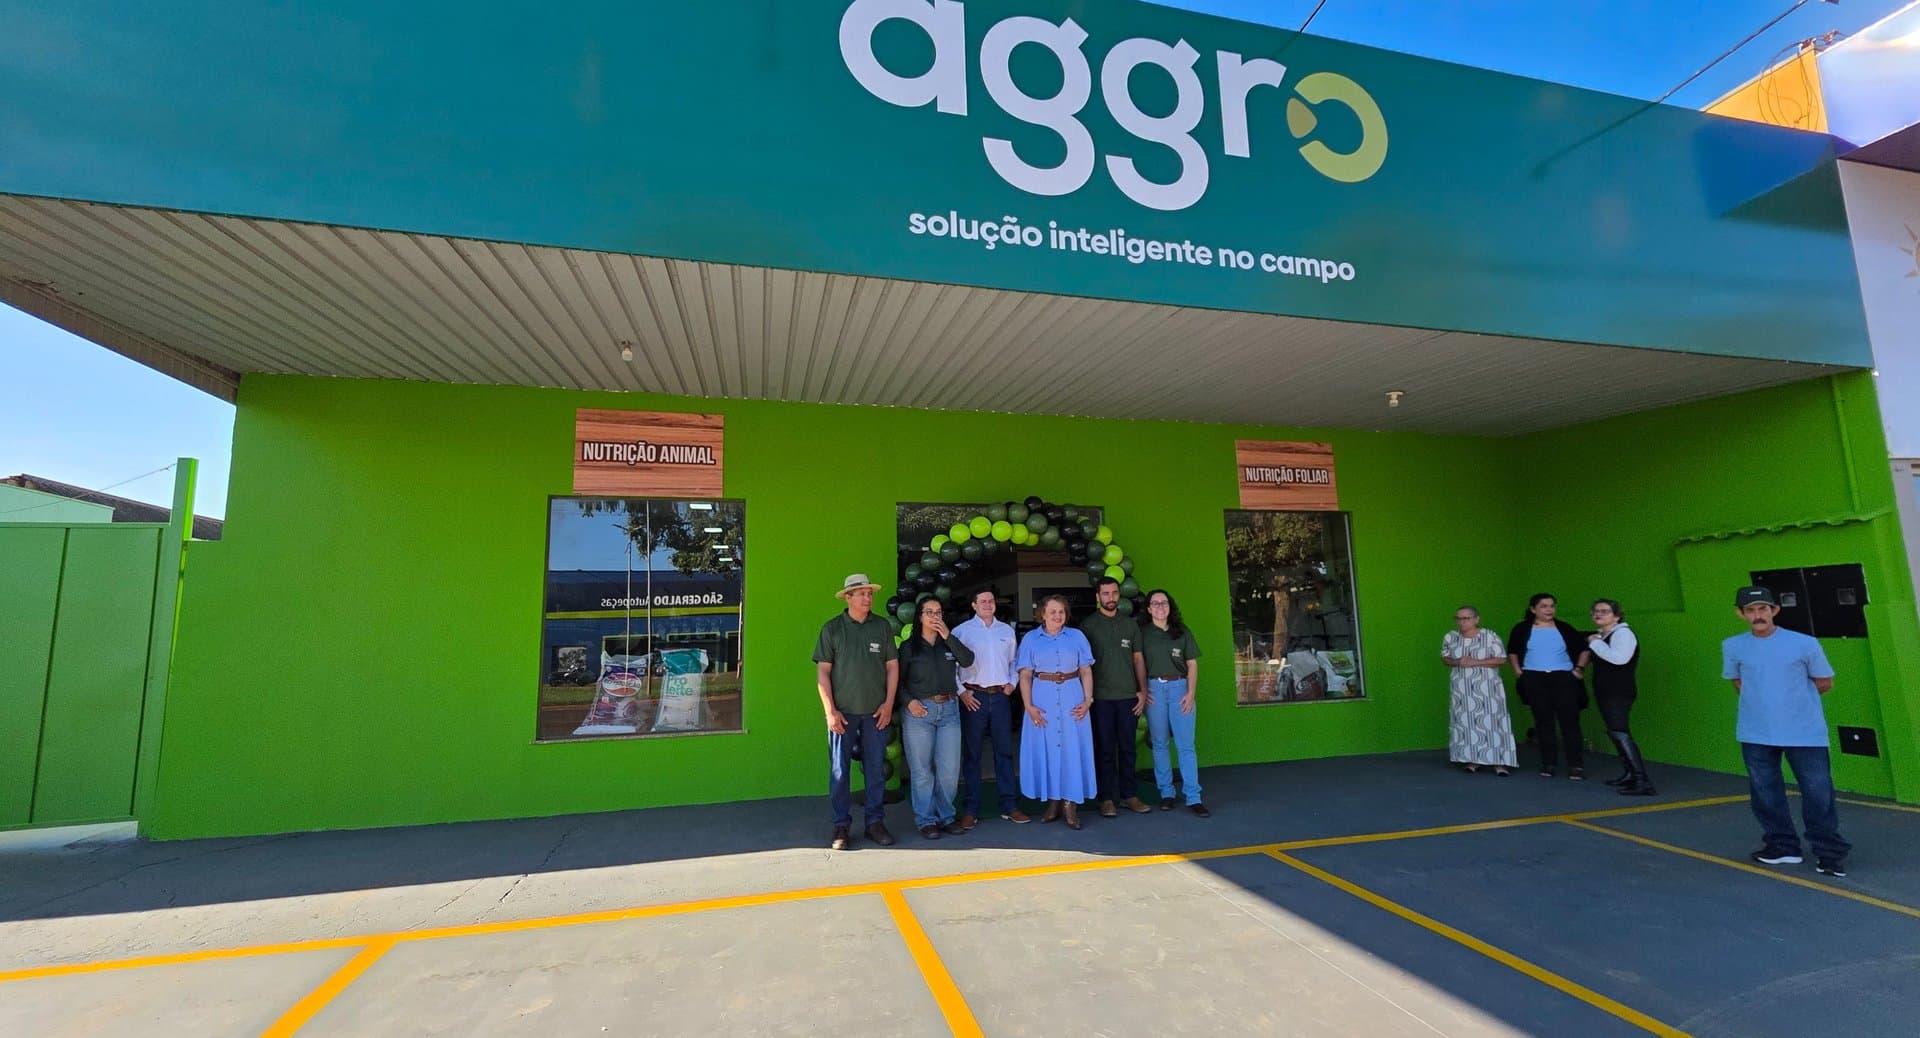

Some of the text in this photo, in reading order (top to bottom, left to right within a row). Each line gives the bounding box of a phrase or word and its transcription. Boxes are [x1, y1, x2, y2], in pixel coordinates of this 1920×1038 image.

[838, 0, 1388, 211] aggro
[908, 210, 1356, 283] solução inteligente no campo
[583, 441, 715, 465] NUTRIÇÃO ANIMAL
[1245, 466, 1328, 485] NUTRIÇÃO FOLIAR
